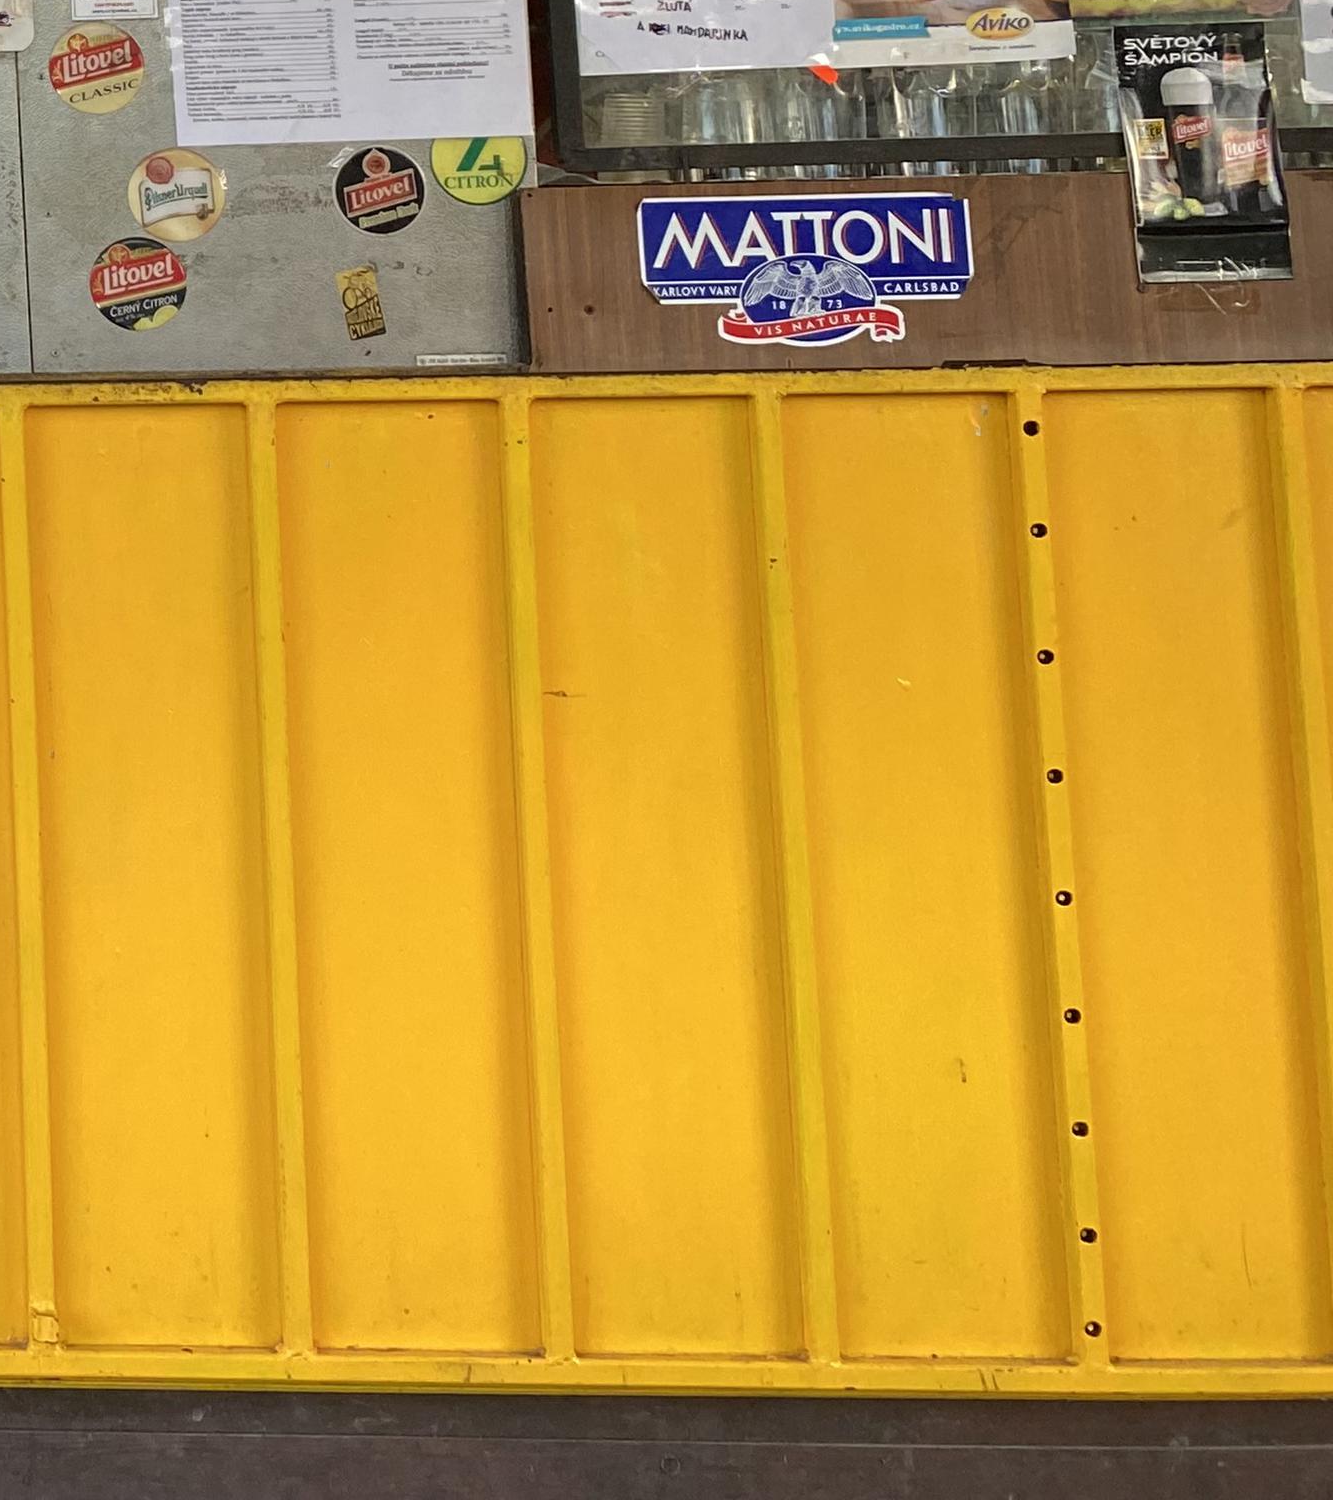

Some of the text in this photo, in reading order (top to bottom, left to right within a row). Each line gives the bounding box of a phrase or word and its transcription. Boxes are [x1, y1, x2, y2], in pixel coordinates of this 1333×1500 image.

[971, 12, 1031, 34] Aviko
[1123, 32, 1218, 51] SVĚTOVÝ
[62, 39, 134, 84] Litovel
[68, 78, 139, 104] CLASSIC
[347, 176, 414, 210] Litovel
[444, 173, 515, 191] CITRON
[652, 208, 955, 270] MATTONI
[102, 252, 175, 297] Litovel
[653, 283, 738, 298] KARLOVY VARY
[884, 282, 961, 295] CARLSBAD
[142, 294, 178, 312] CITRON
[753, 312, 877, 337] VIS NATURAE
